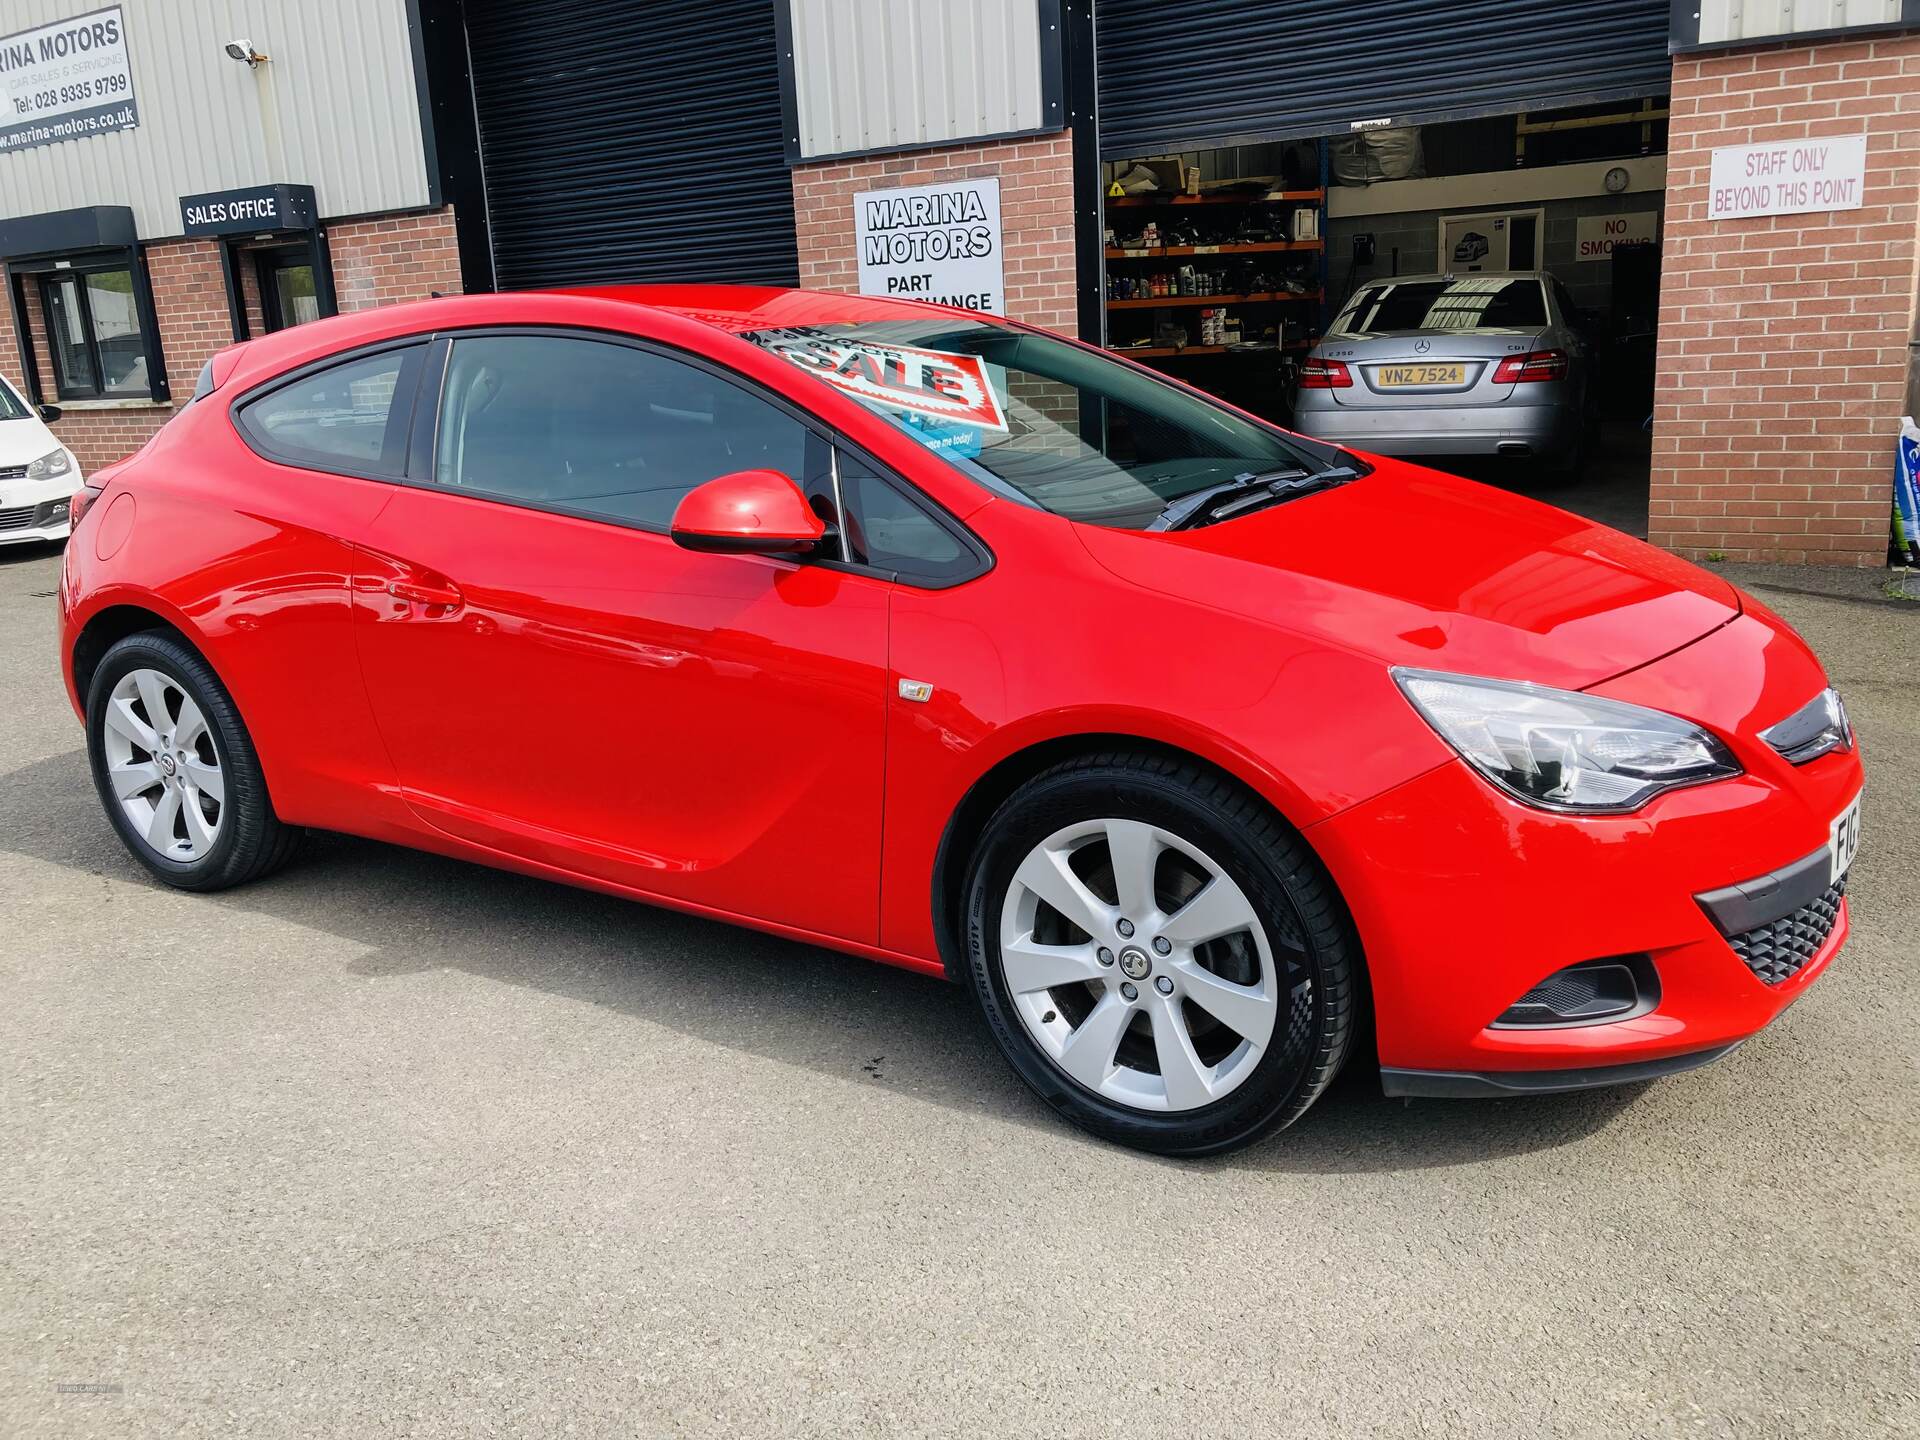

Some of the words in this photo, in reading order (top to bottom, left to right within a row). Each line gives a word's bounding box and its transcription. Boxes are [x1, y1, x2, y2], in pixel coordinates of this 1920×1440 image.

[39, 19, 119, 62] MOTORS
[31, 68, 60, 84] SALES
[72, 53, 124, 74] SERVICING
[13, 95, 33, 114] Tel:
[35, 89, 58, 109] 028
[60, 81, 92, 103] 9335
[94, 73, 127, 96] 9799
[1746, 150, 1788, 177] STAFF
[1792, 147, 1828, 173] ONLY
[186, 203, 227, 225] SALES
[229, 198, 277, 220] OFFICE
[866, 190, 987, 231] MARINA
[1715, 185, 1771, 213] BEYOND
[1777, 182, 1808, 207] THIS
[1813, 178, 1857, 204] POINT
[1605, 219, 1627, 235] NO
[865, 225, 992, 266] MOTORS
[887, 274, 932, 293] PART
[789, 346, 977, 406] SALE
[1385, 368, 1413, 383] VNZ
[1420, 366, 1457, 381] 7524
[953, 432, 973, 446] today!
[1837, 806, 1857, 870] FIG
[970, 920, 981, 956] 101Y
